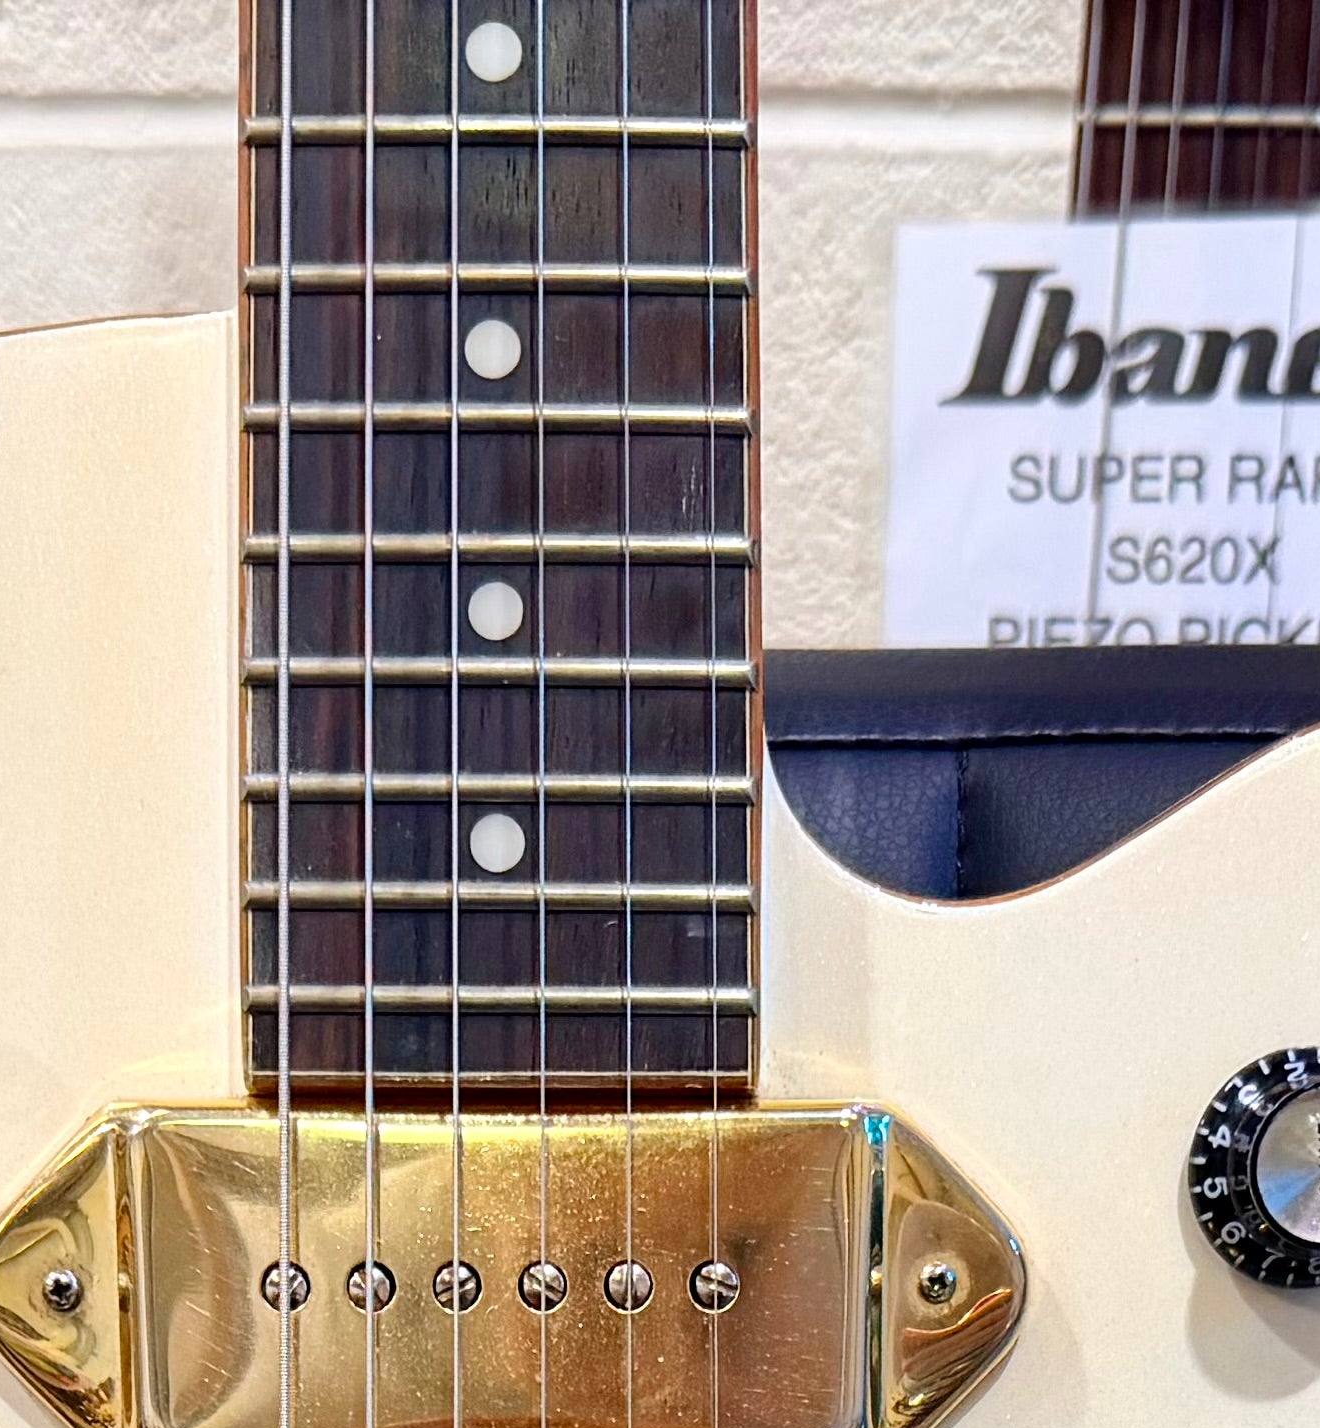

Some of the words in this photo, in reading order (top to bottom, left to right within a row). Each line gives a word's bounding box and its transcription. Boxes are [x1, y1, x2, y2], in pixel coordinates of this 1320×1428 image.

[1007, 451, 1207, 504] SUPER
[1105, 533, 1283, 587] S620X
[1207, 1125, 1232, 1151] 4
[1203, 1176, 1230, 1200] 5
[1220, 1220, 1247, 1245] 6
